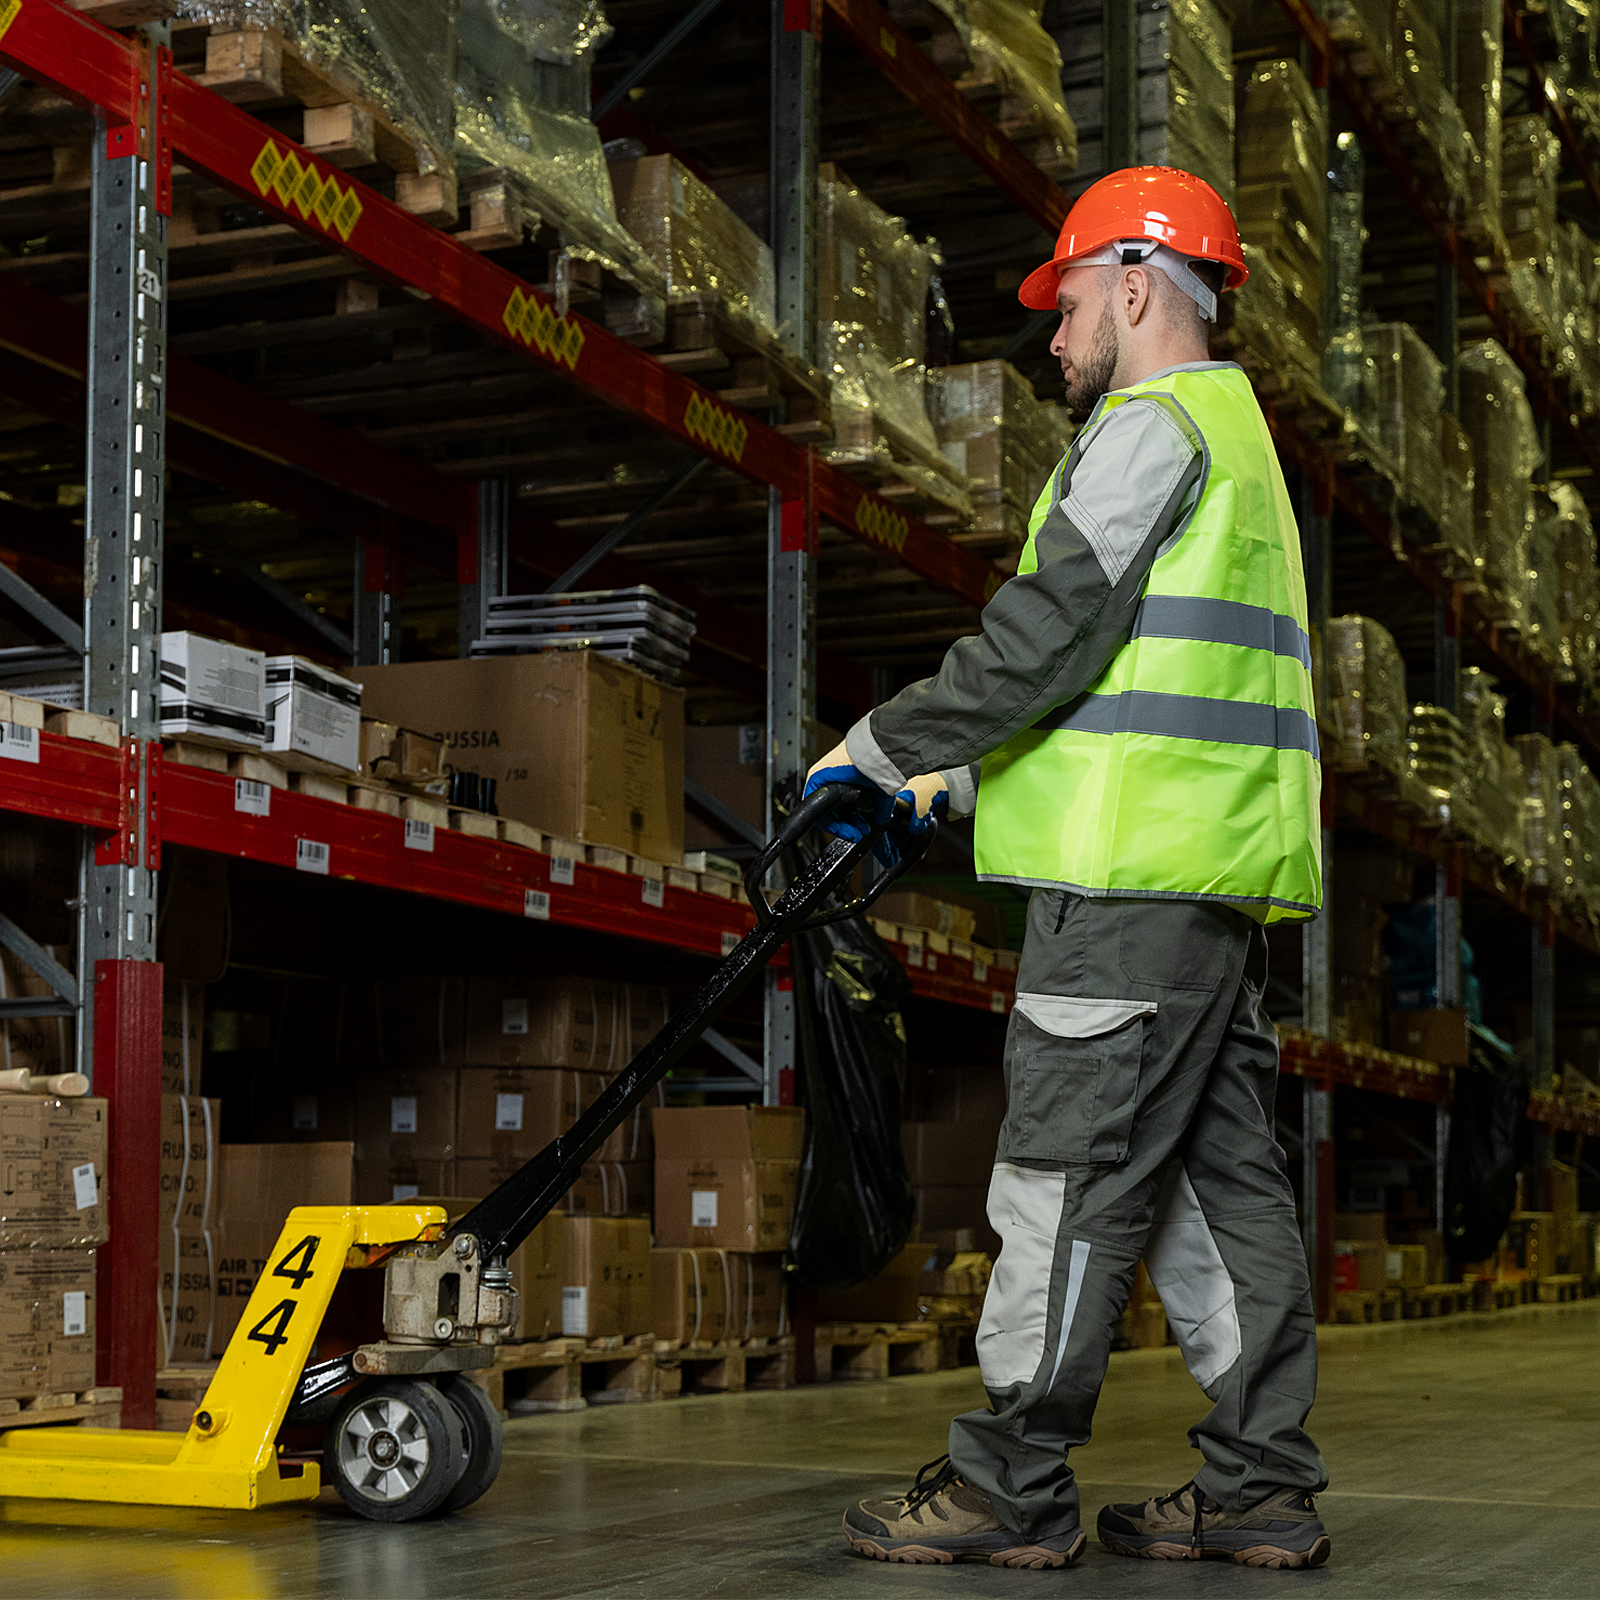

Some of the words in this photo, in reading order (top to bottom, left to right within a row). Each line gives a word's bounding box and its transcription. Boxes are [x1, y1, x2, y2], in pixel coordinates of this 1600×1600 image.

[142, 273, 155, 292] 21
[161, 1141, 207, 1160] RUSI
[219, 1258, 246, 1273] AIR
[272, 1234, 321, 1290] 4
[163, 1272, 210, 1291] RSSIA
[247, 1298, 298, 1355] 4
